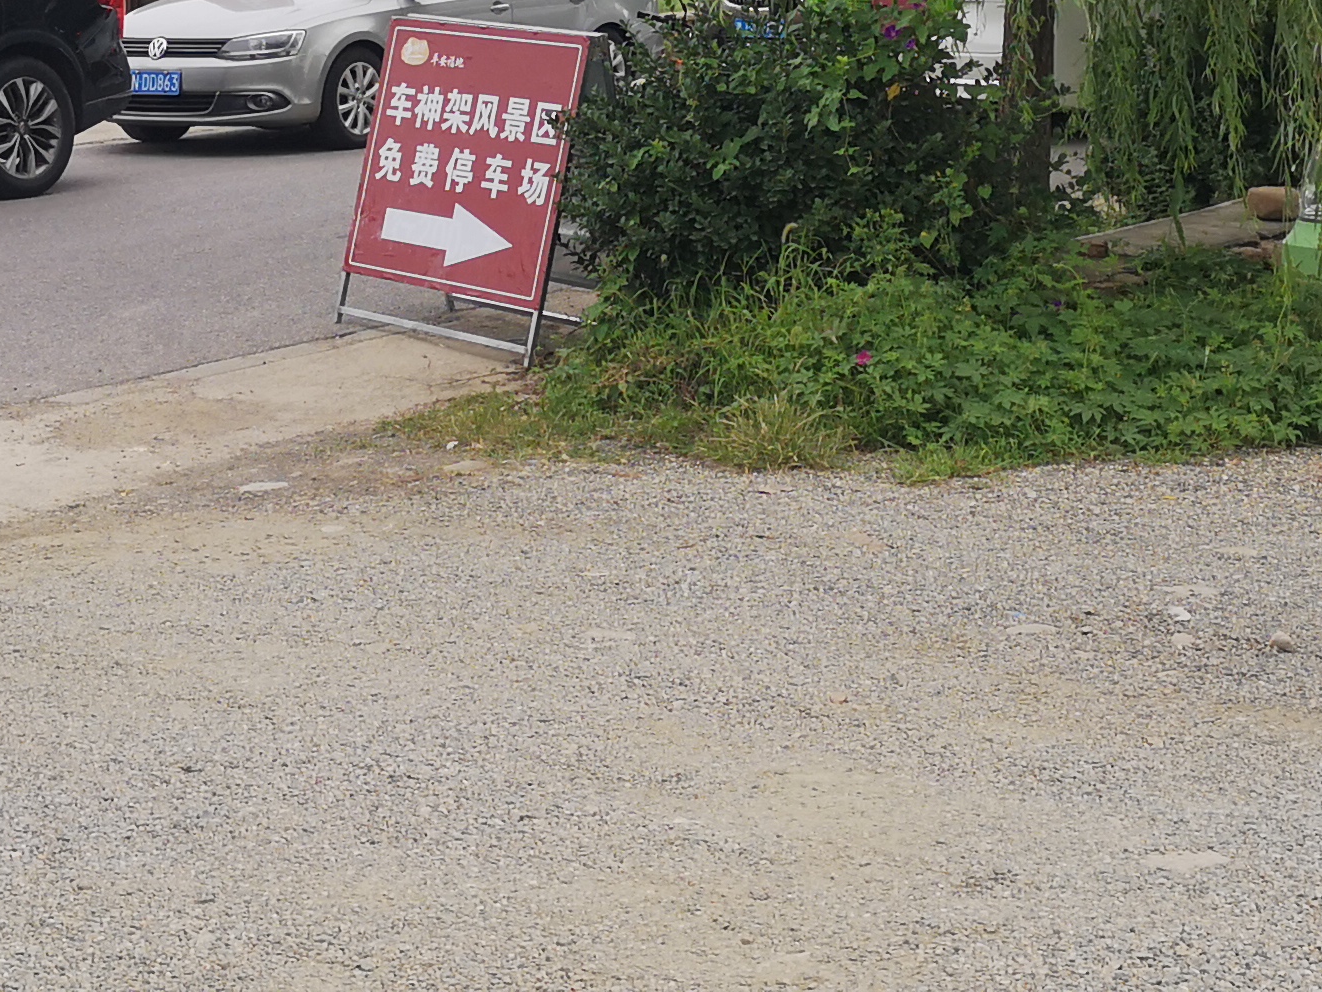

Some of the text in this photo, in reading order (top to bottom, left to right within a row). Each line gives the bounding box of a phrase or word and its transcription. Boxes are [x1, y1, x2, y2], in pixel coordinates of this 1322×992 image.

[385, 82, 563, 146] 车神架风景区
[375, 137, 553, 206] 免费停车场
